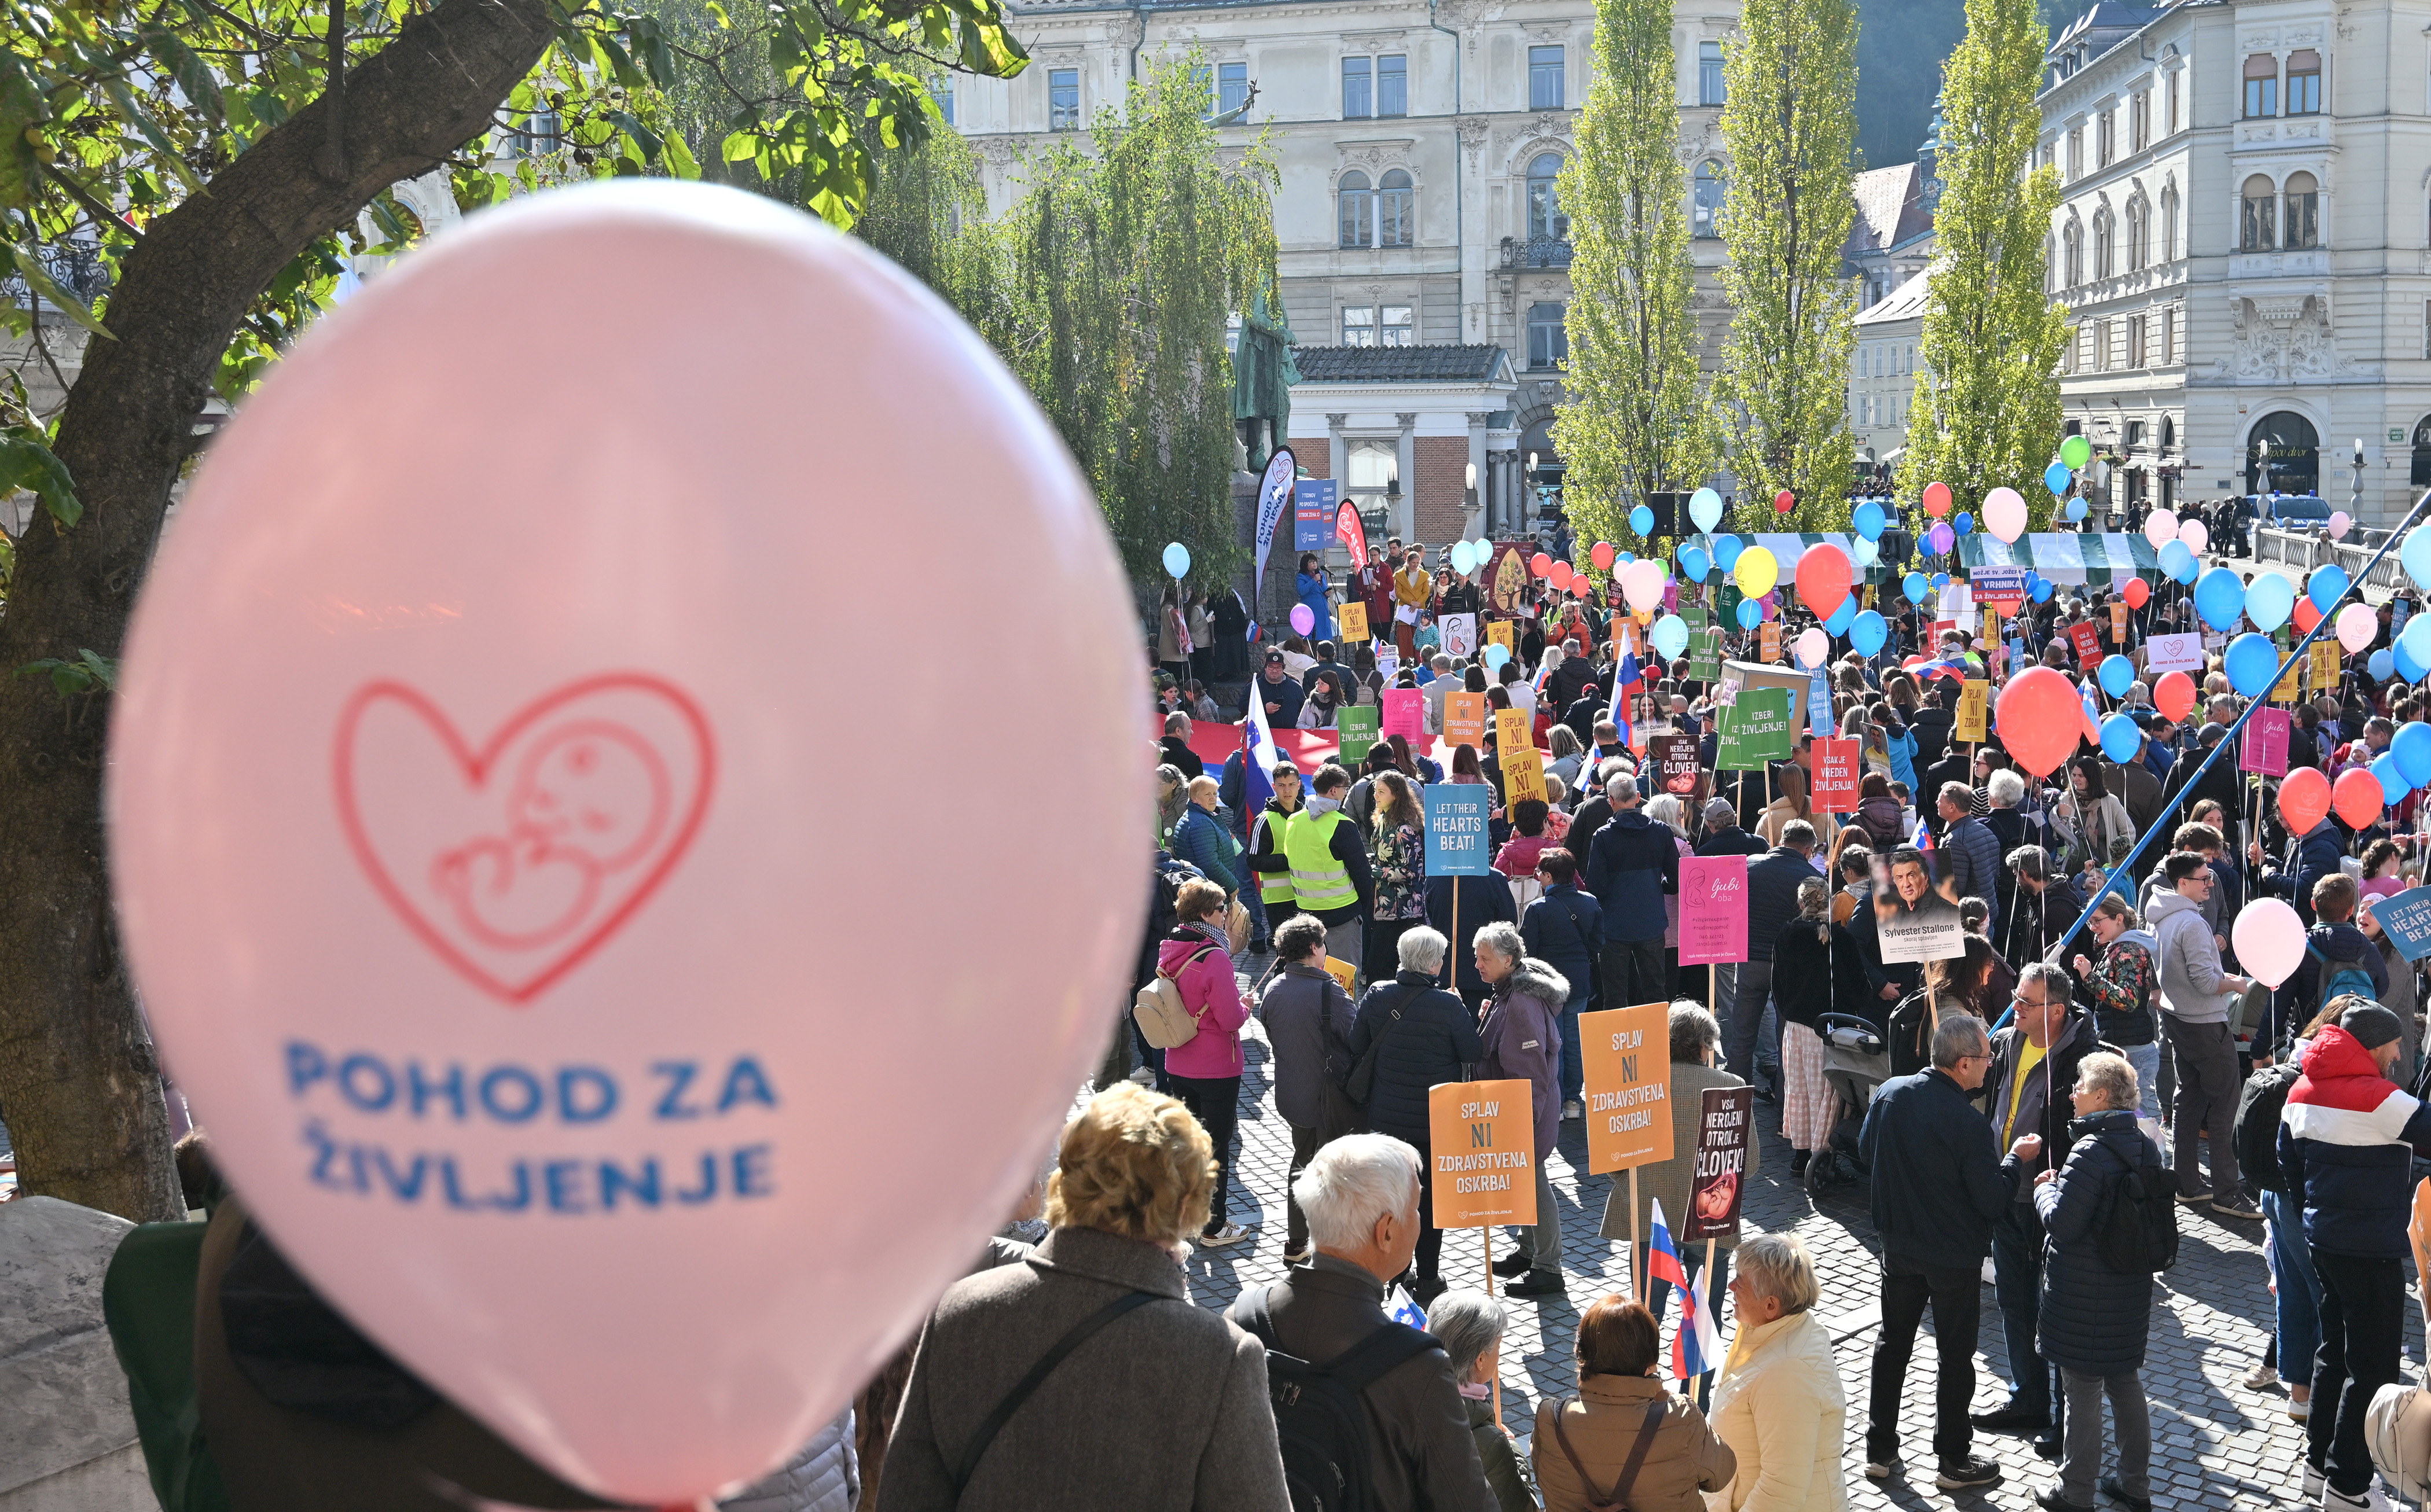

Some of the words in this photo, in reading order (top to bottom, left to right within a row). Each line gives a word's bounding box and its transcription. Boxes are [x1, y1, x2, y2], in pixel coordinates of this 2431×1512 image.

[2287, 446, 2308, 457] dvor
[1257, 501, 1273, 545] POHOD
[1984, 580, 2021, 588] VRHNIKA
[1345, 608, 1360, 616] SPLAV
[1349, 616, 1358, 626] NI
[1346, 626, 1364, 634] ZDRAV!
[1493, 627, 1508, 635] SPLAV
[2080, 639, 2094, 648] VREDEN
[2079, 645, 2099, 657] ŽIVLJENJA!
[2316, 648, 2333, 656] SPLAV
[1692, 654, 1718, 664] ŽIVLJENJE!
[2321, 657, 2329, 669] NI
[2316, 669, 2335, 678] ZDRAV!
[1967, 689, 1982, 699] SPLAV
[1402, 700, 1419, 711] ljubi
[1970, 700, 1978, 716] NI
[1460, 709, 1468, 719] NI
[1751, 709, 1774, 721] IZBERI
[1446, 719, 1481, 727] ZDRAVSTVENA
[1504, 716, 1525, 728] SPLAV
[1741, 721, 1786, 735] ŽIVLJENJE!
[1964, 718, 1981, 728] ZDRAV!
[2265, 721, 2285, 734] ljubi
[1341, 731, 1377, 742] ŽIVLJENJE!
[1511, 728, 1522, 744] NI
[1670, 745, 1695, 753] NEROJENI
[1671, 753, 1688, 761] OTROK
[1823, 756, 1838, 764] VSAK
[1839, 756, 1846, 764] JE
[1508, 760, 1532, 776] SPLAV
[1663, 760, 1699, 774] ČLOVEK!
[1821, 767, 1848, 778] VREDEN
[1515, 772, 1530, 793] NI
[1815, 779, 1854, 791] ŽIVLJENJA!
[1436, 803, 1451, 814] LET
[1453, 803, 1478, 814] THEIR
[1433, 817, 1482, 832] HEARTS
[1440, 835, 1475, 851] BEAT!
[1711, 877, 1740, 899] ljubi
[1718, 893, 1732, 902] oba
[2388, 908, 2405, 921] LET
[2404, 899, 2431, 914] THEIR
[1885, 927, 1920, 938] Sylvester
[1922, 924, 1955, 935] Stallone
[1612, 1029, 1643, 1051] SPLAV
[1622, 1054, 1637, 1083] NI
[282, 1038, 619, 1125] POHOD
[649, 1054, 778, 1119] ZA
[1592, 1083, 1665, 1112] ZDRAVSTVENA
[1461, 1101, 1500, 1119] SPLAV
[1721, 1098, 1735, 1110] VSAK
[1609, 1109, 1652, 1134] OSKRBA!
[1706, 1110, 1743, 1128] NEROJENI
[1471, 1123, 1492, 1148] NI
[1706, 1130, 1733, 1147] OTROK
[1733, 1132, 1739, 1145] JE
[1637, 1146, 1653, 1155] ŽIVLJENJE
[301, 1117, 776, 1215] ŽIVLJENJE
[1438, 1152, 1528, 1172] ZDRAVSTVENA
[1696, 1147, 1744, 1178] ČLOVEK!
[1456, 1174, 1511, 1194] OSKRBA!
